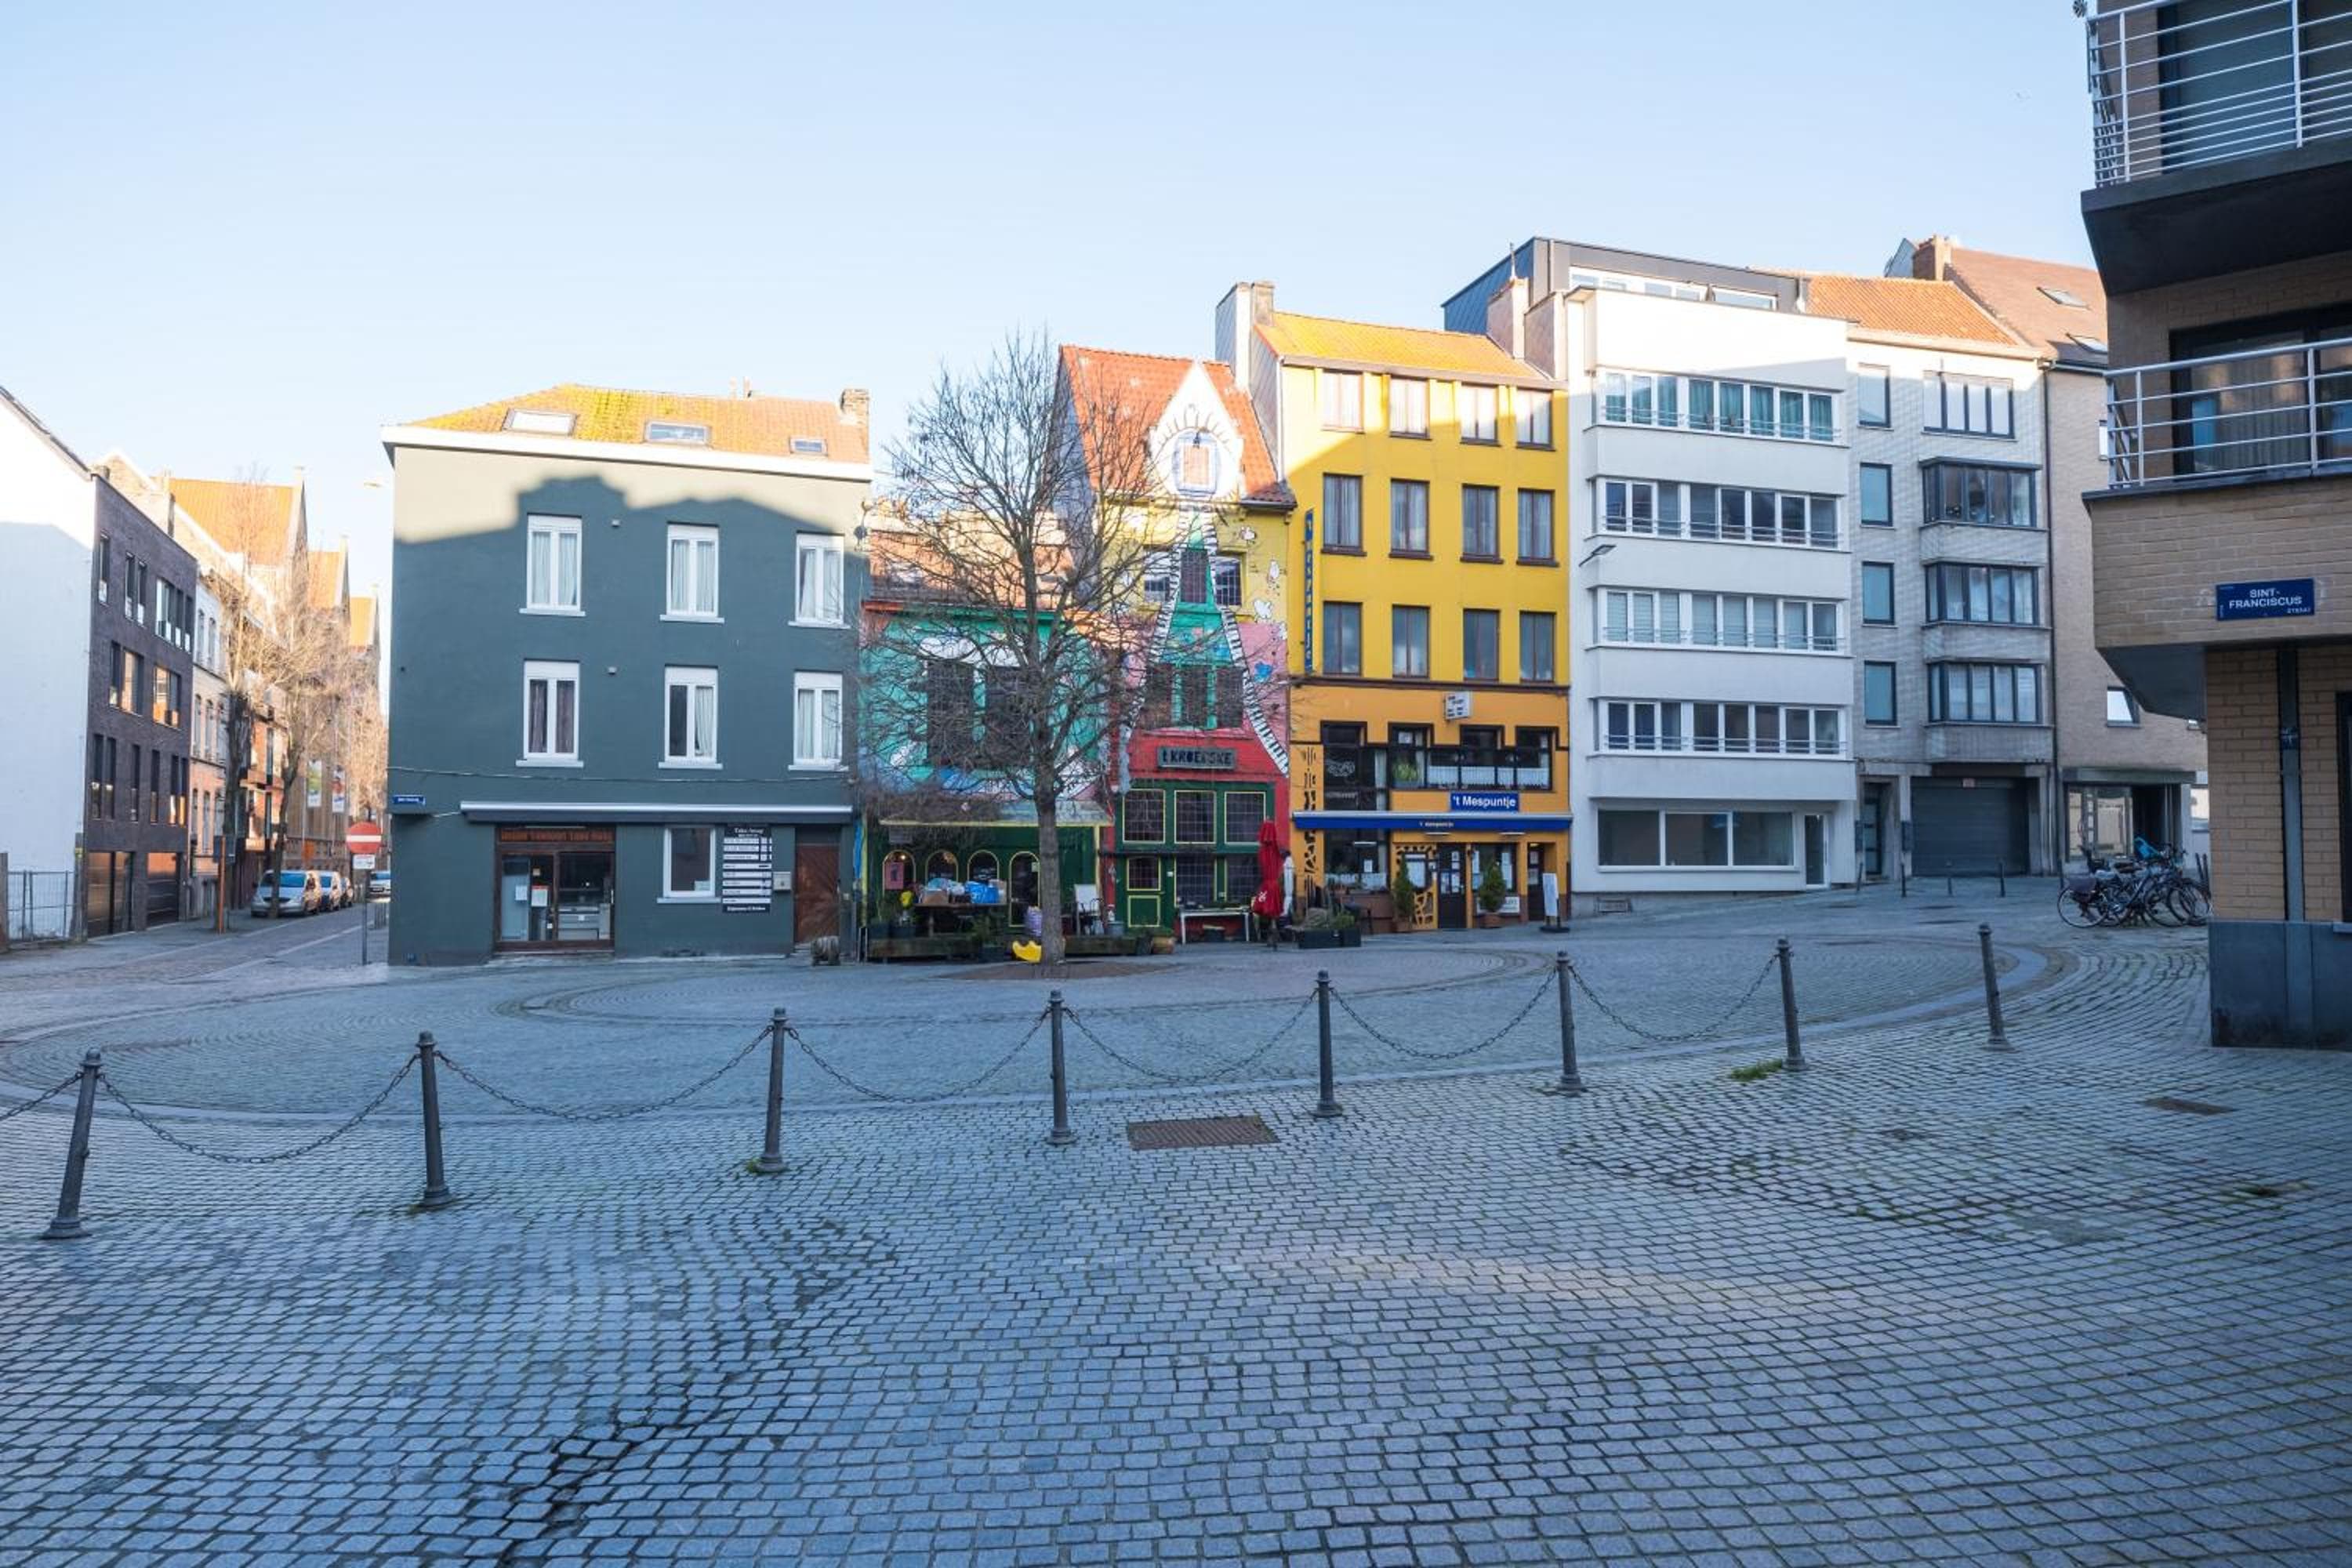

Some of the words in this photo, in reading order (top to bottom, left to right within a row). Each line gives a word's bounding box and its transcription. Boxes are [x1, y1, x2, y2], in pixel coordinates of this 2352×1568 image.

[2249, 587, 2280, 598] SINT-
[2229, 596, 2303, 609] FRANCISCUS
[1453, 796, 1460, 806] 't
[1462, 796, 1516, 809] Mespuntje
